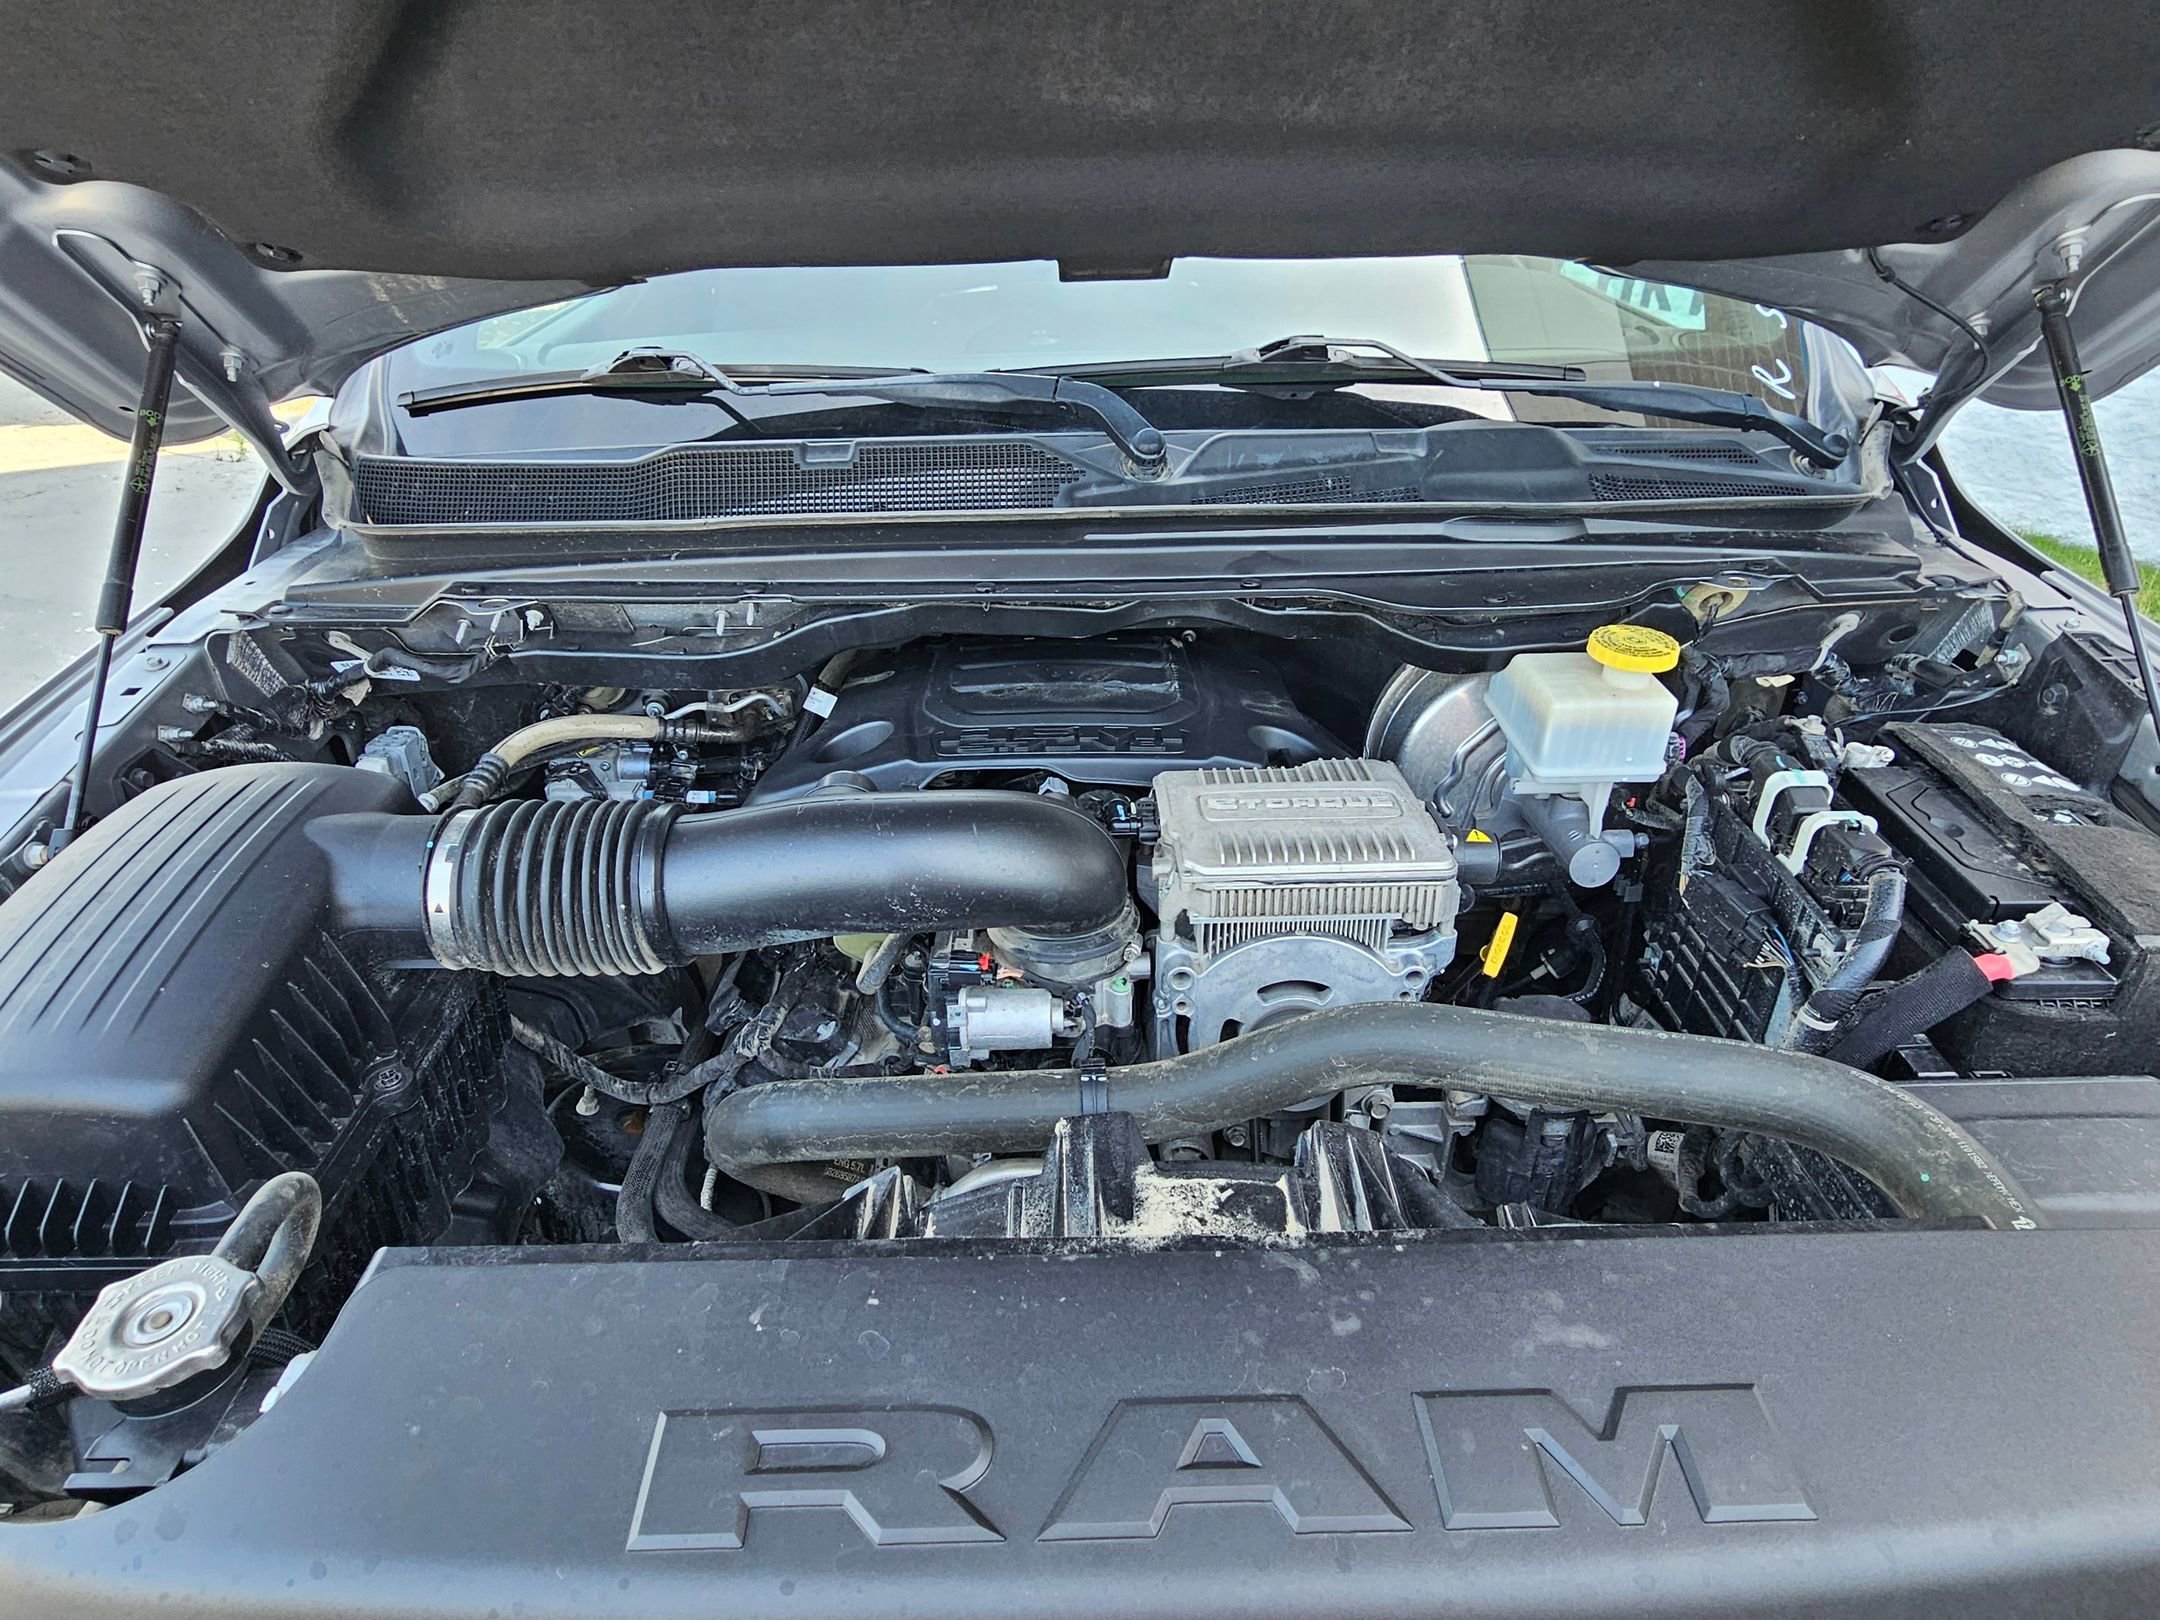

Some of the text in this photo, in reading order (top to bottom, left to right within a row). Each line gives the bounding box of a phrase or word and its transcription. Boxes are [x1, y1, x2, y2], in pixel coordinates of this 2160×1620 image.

[113, 1350, 170, 1376] OPEN
[171, 1320, 208, 1354] HOT
[626, 1382, 1819, 1552] RAM
